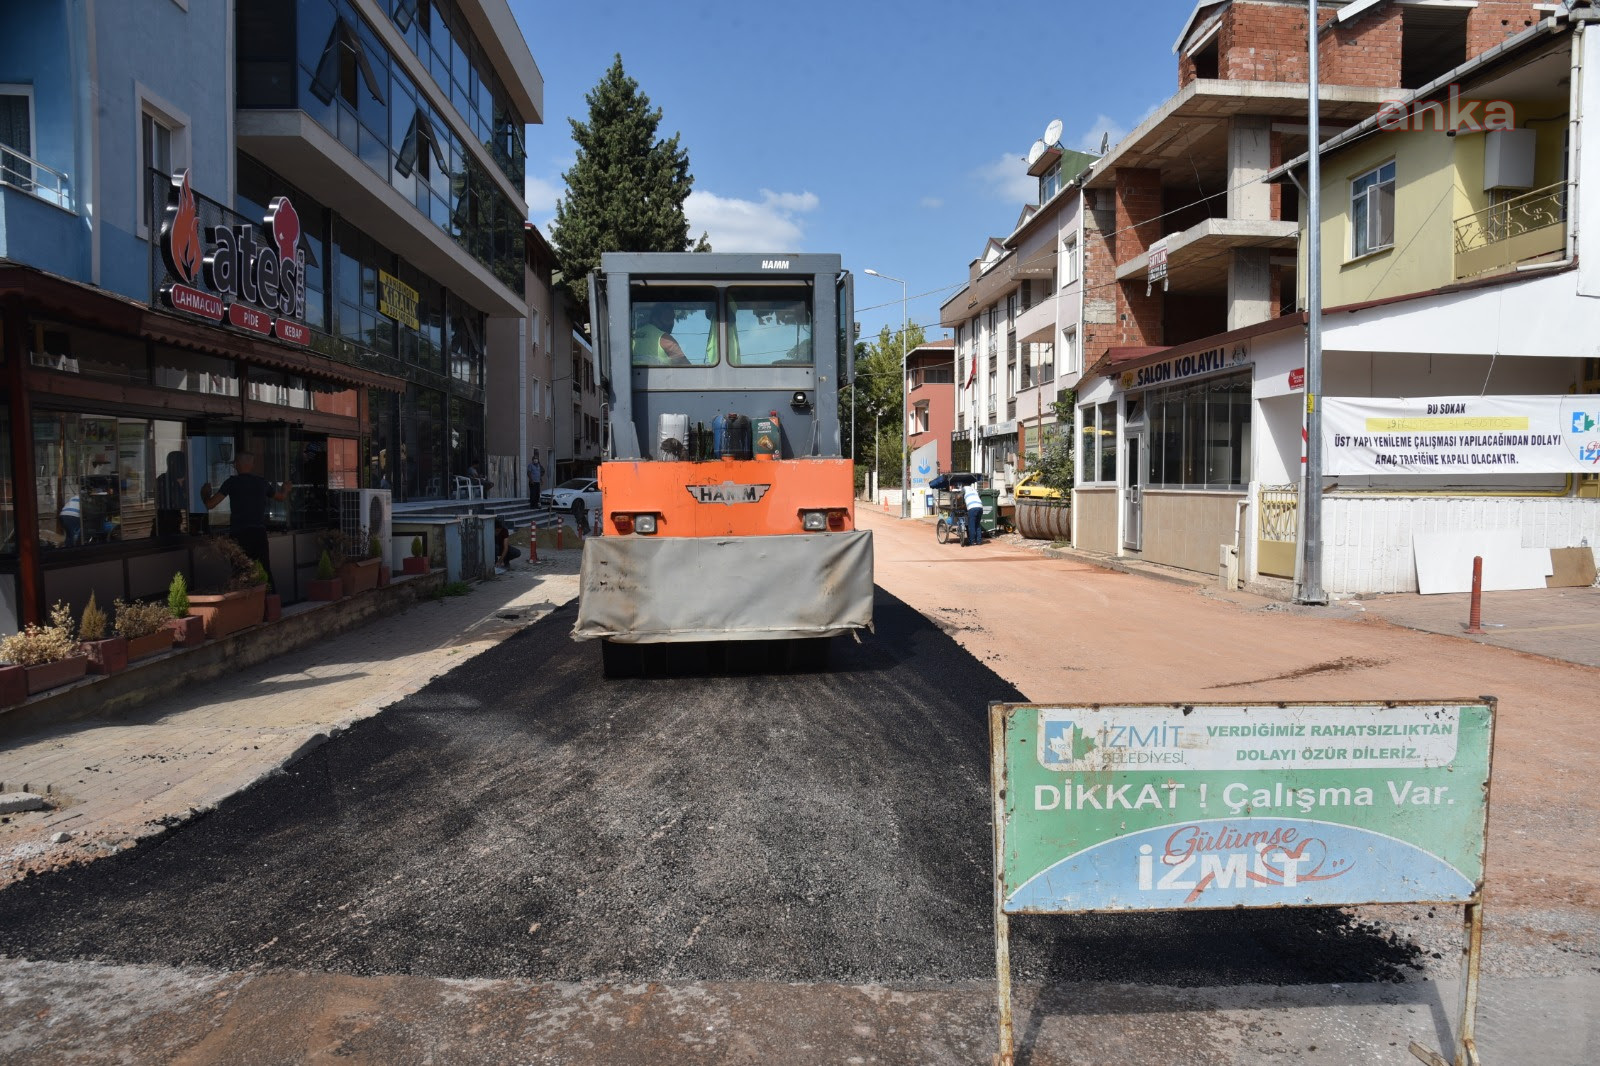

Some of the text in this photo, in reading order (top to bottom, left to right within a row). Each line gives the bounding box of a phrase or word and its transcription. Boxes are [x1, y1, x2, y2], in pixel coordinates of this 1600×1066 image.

[761, 260, 790, 270] HAMM
[175, 289, 222, 316] LAHMACUN
[243, 310, 259, 328] PİDE
[284, 324, 302, 339] KEBAP
[1137, 347, 1225, 387] SALON KOLAYLI
[1427, 403, 1466, 415] BU SOKAK
[1334, 432, 1561, 449] ÜST YAPI YENİLEME ÇALIŞMASI YAPILACAĞINDAN DOLAYI
[1375, 453, 1519, 467] ARAÇ TRAFİĞİNE KAPALI OLACAKTIR.
[1101, 720, 1185, 748] İZMİT
[1206, 722, 1453, 737] VERDİĞİMİZ RAHATSIZLIKTAN
[1102, 750, 1185, 764] BELEDİYESİ
[1236, 745, 1421, 761] DOLAYI ÖZÜR DİLERİZ.
[1034, 778, 1455, 814] DİKKAT ! Çalışma Var.
[1163, 825, 1300, 866] Gülümse
